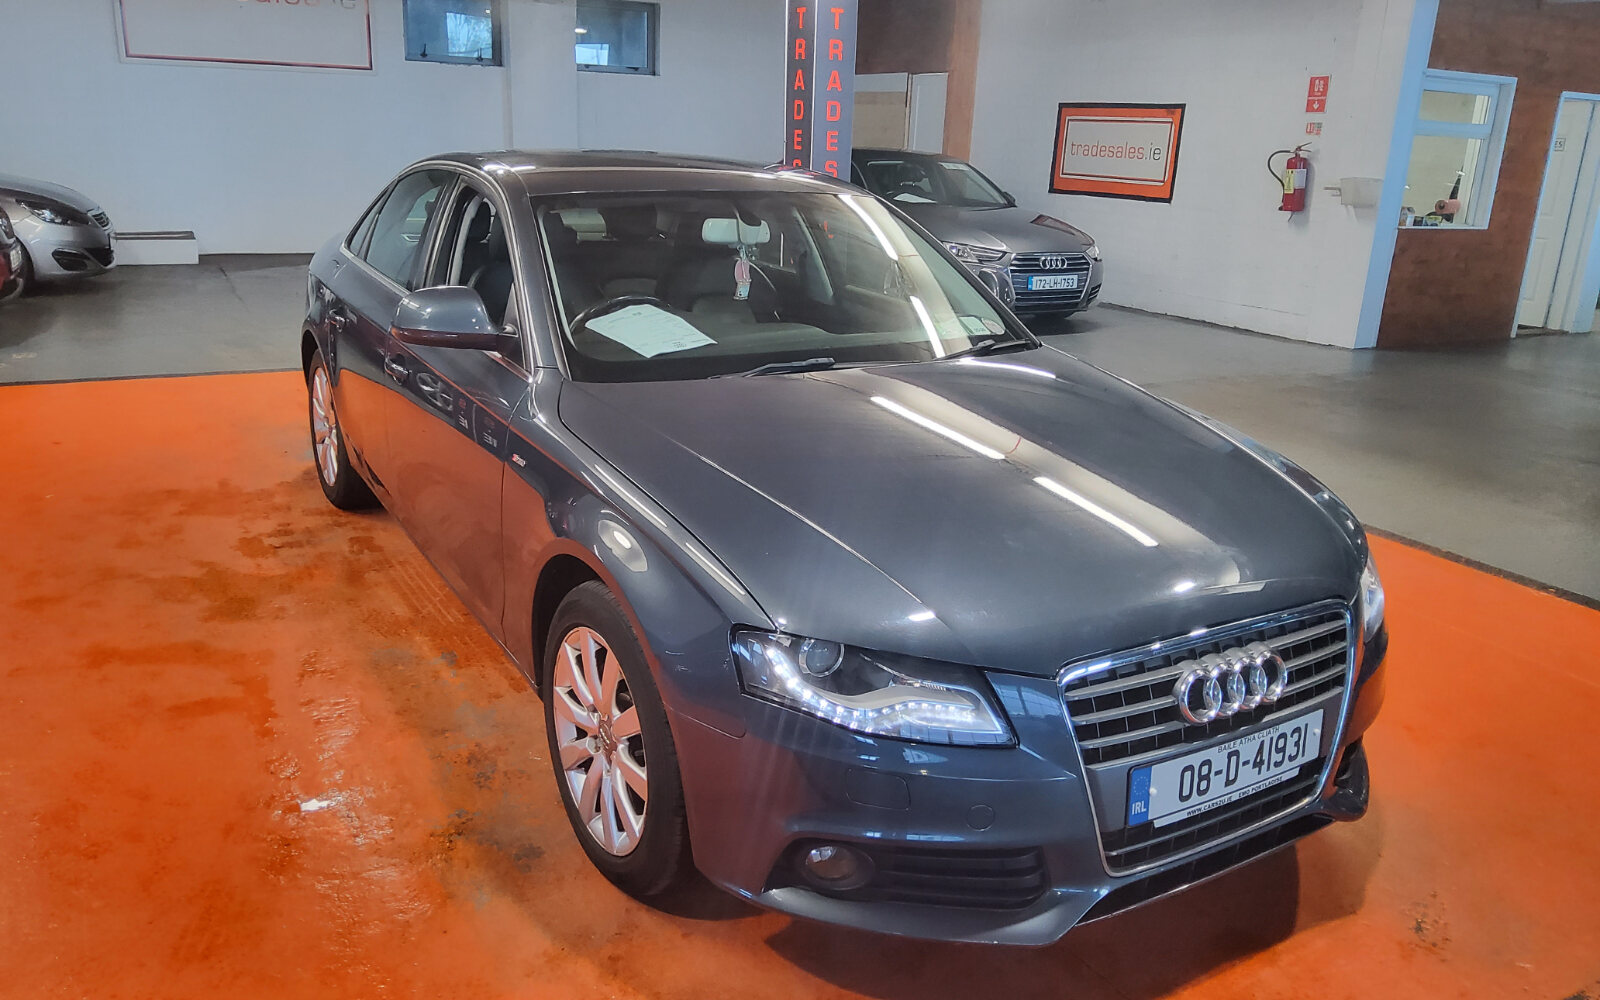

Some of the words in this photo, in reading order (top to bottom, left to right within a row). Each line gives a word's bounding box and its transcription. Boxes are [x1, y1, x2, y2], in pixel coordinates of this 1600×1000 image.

[1070, 140, 1162, 161] tradesales.ie
[1035, 277, 1075, 289] 172-LH-1753
[1217, 741, 1238, 754] BAILE
[1257, 725, 1281, 740] CLIATH
[1178, 723, 1309, 803] 08-D-41931
[1131, 801, 1147, 816] IRL
